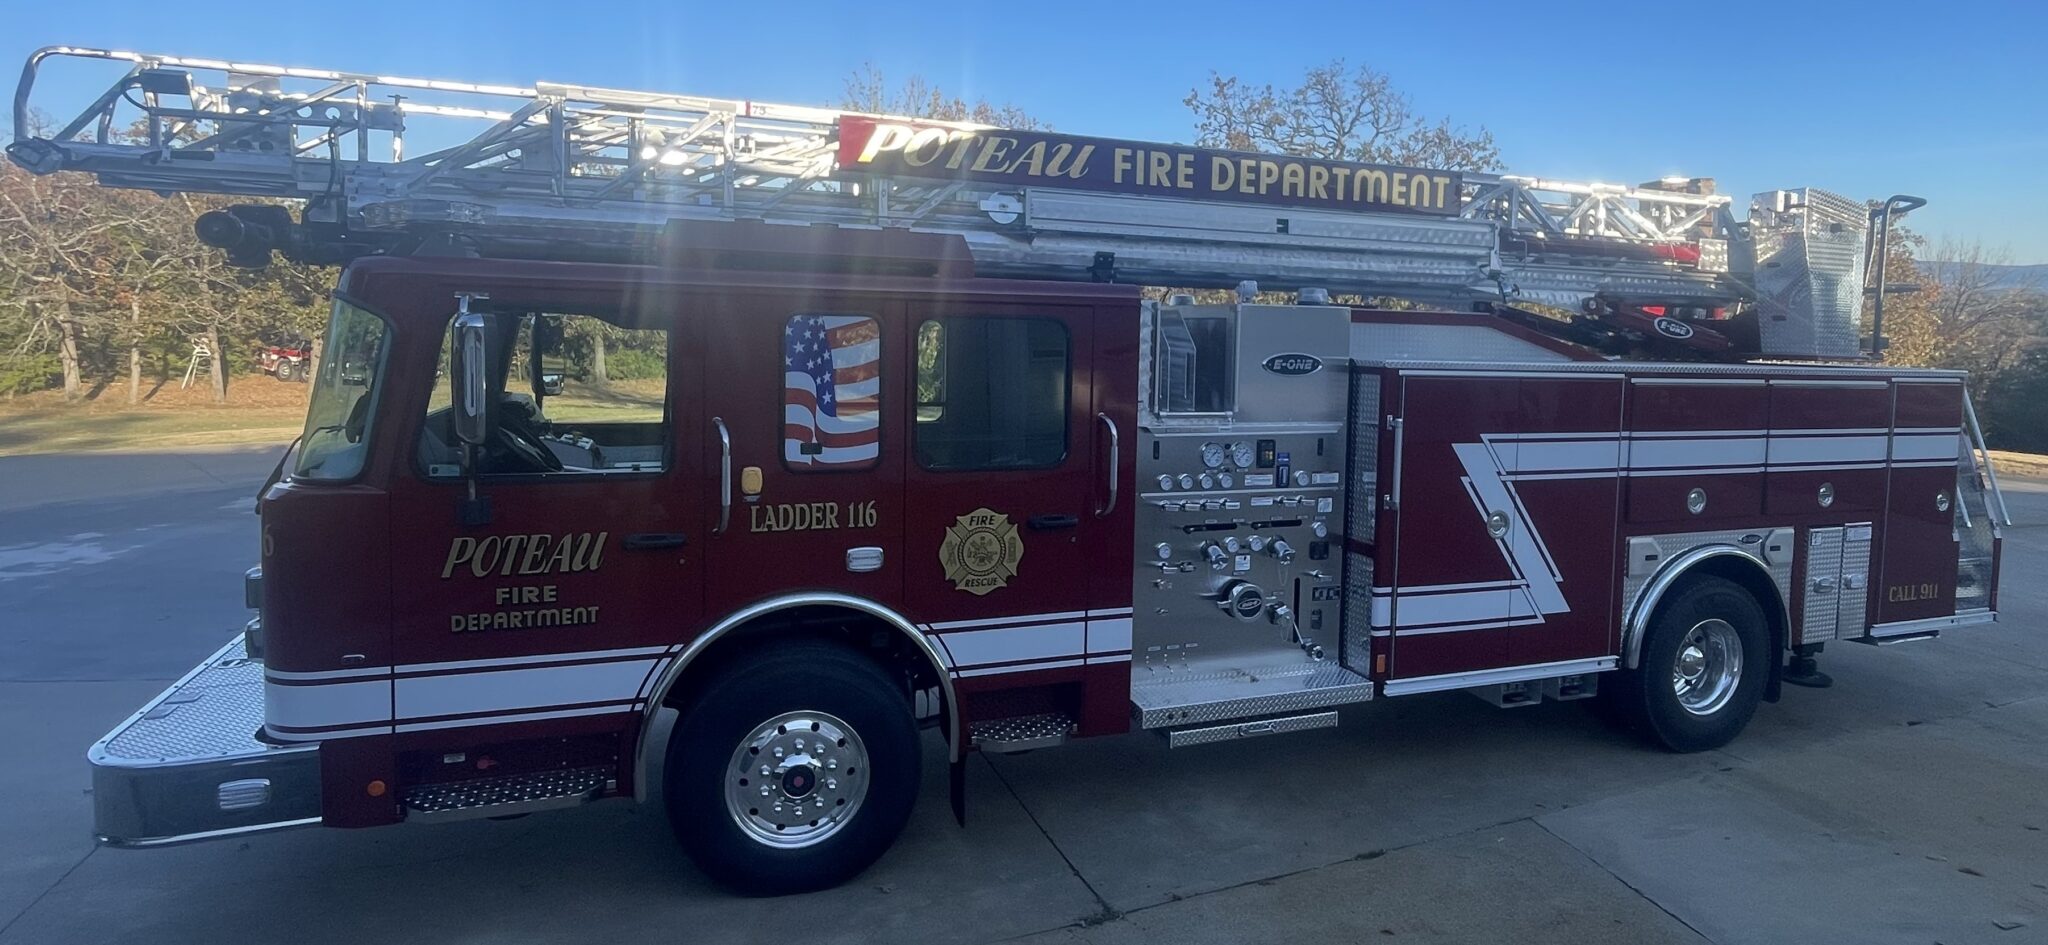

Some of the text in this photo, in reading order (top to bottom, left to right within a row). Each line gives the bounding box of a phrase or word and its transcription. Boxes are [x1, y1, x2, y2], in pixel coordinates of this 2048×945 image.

[752, 105, 767, 116] 75
[857, 123, 1450, 209] POTEAU FIRE DEPARTMENT
[1273, 359, 1314, 370] E-ONE
[750, 500, 877, 532] LADDER 116
[968, 514, 997, 526] FIRE
[441, 531, 608, 578] POTEAU
[964, 577, 998, 587] RESCUE
[495, 585, 557, 605] FIRE
[1889, 583, 1938, 602] CALL 911
[451, 606, 599, 632] DEPARTMENT
